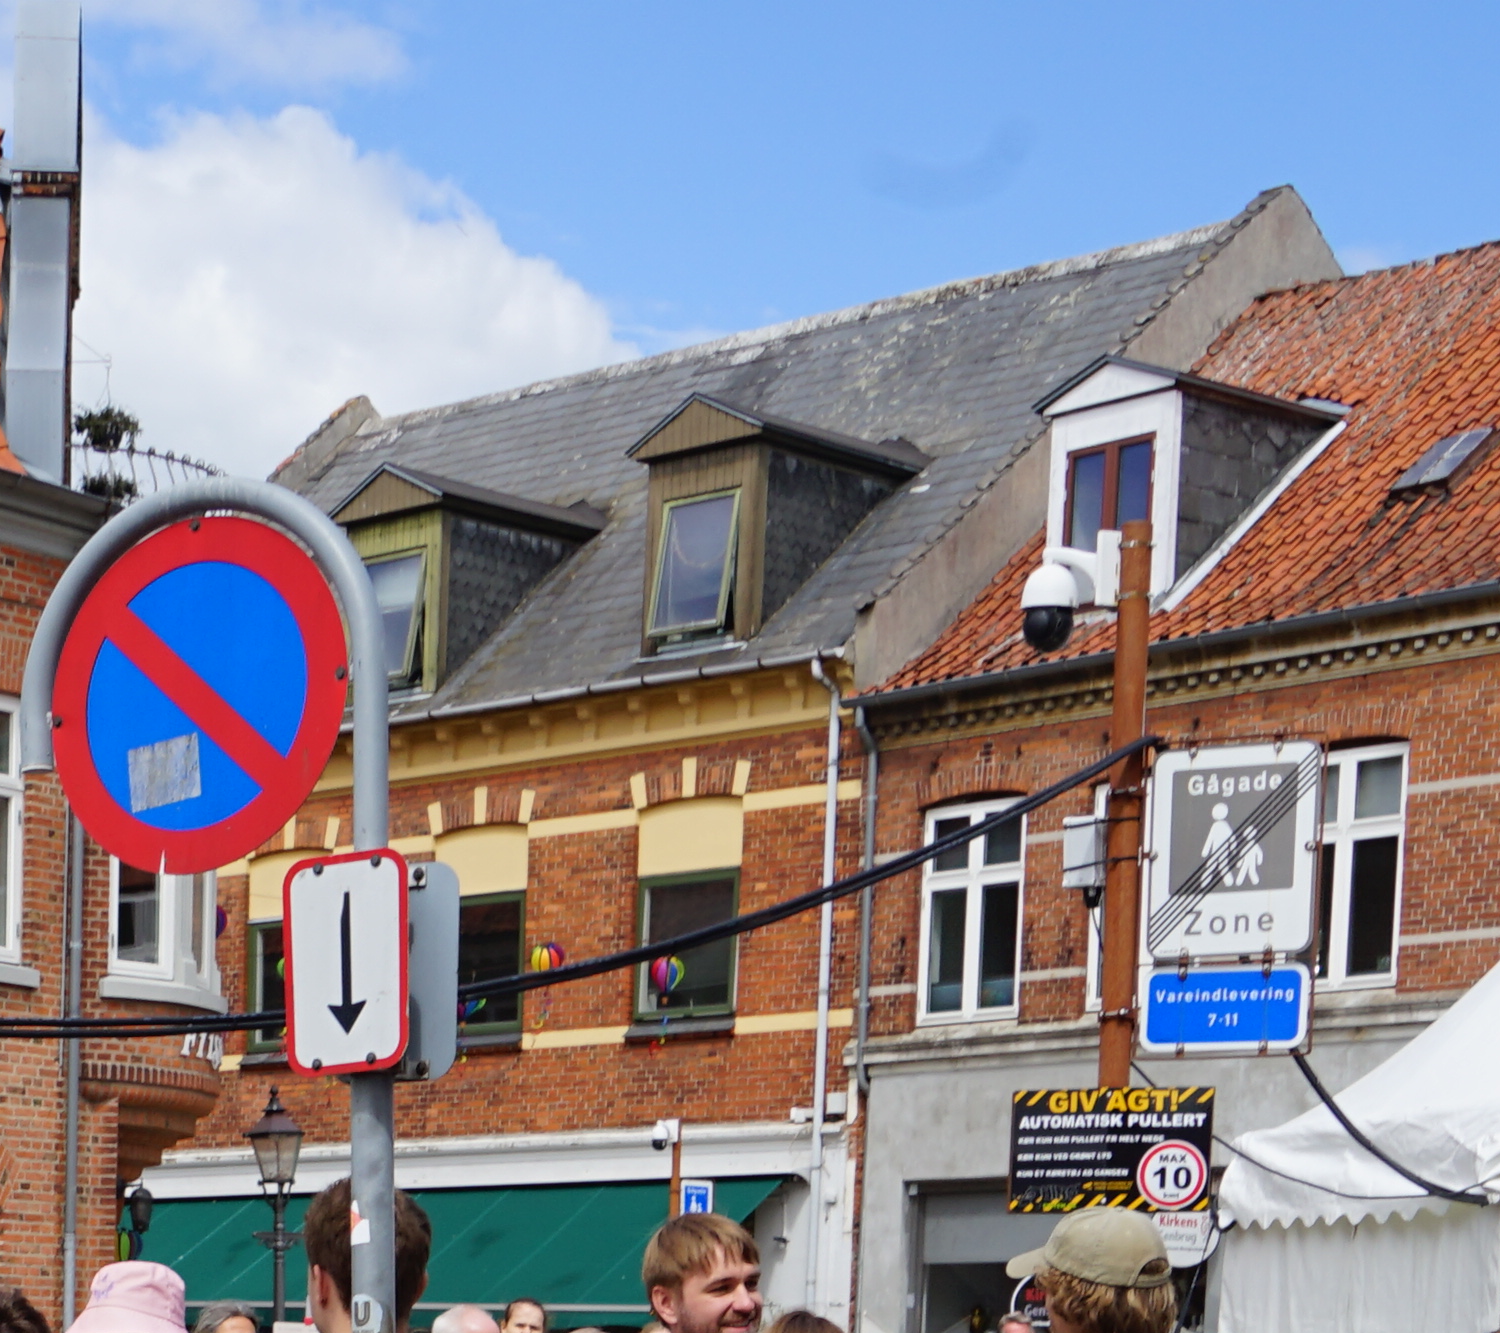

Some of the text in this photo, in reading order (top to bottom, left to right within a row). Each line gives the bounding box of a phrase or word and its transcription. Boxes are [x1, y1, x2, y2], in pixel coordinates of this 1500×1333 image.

[1187, 770, 1282, 797] Gågade
[1183, 909, 1274, 936] Zone
[1155, 985, 1294, 1005] Vareindlevering
[1049, 1088, 1179, 1113] GIV AGT!
[1019, 1112, 1207, 1130] AUTOMATISK PULLERT
[1159, 1153, 1187, 1163] MAX
[1153, 1166, 1192, 1190] 10
[1159, 1214, 1199, 1229] Kirkens
[354, 1300, 371, 1327] U
[1024, 1303, 1049, 1317] Gen
